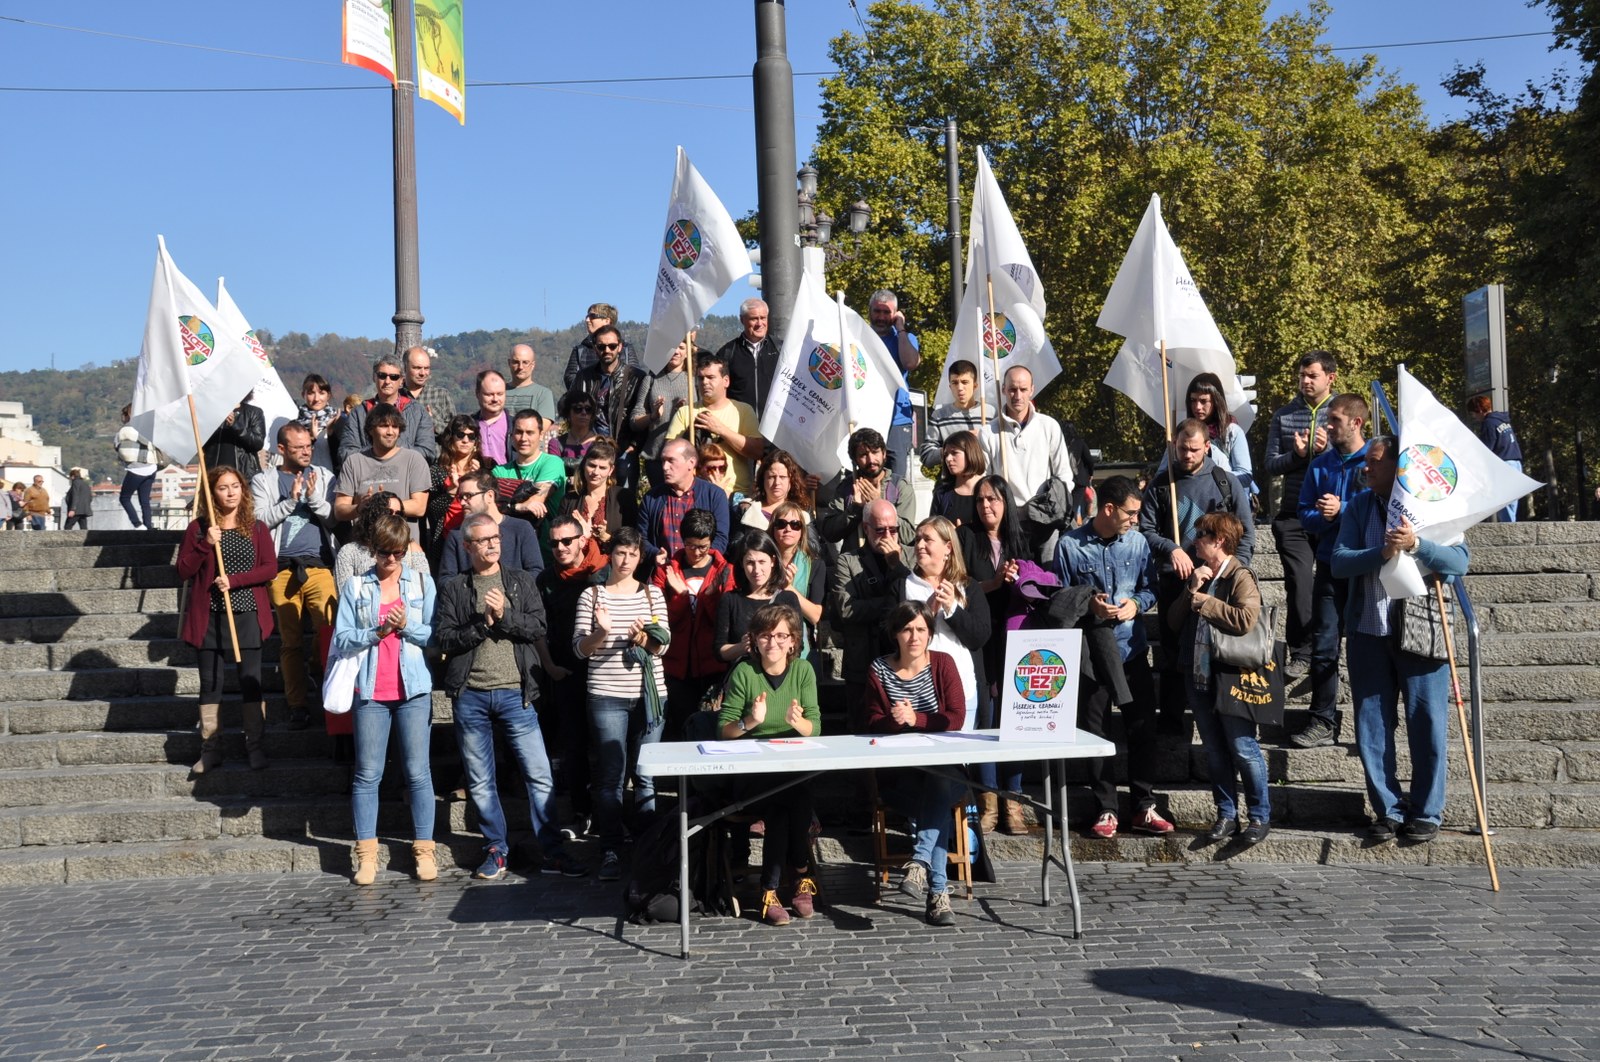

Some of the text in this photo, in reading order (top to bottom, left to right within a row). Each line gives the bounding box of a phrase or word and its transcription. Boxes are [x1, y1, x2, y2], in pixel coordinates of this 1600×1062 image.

[818, 361, 837, 381] EZ
[1017, 666, 1065, 675] TTIP/CETA
[1030, 675, 1051, 689] EZ
[1229, 685, 1273, 705] WELCOME
